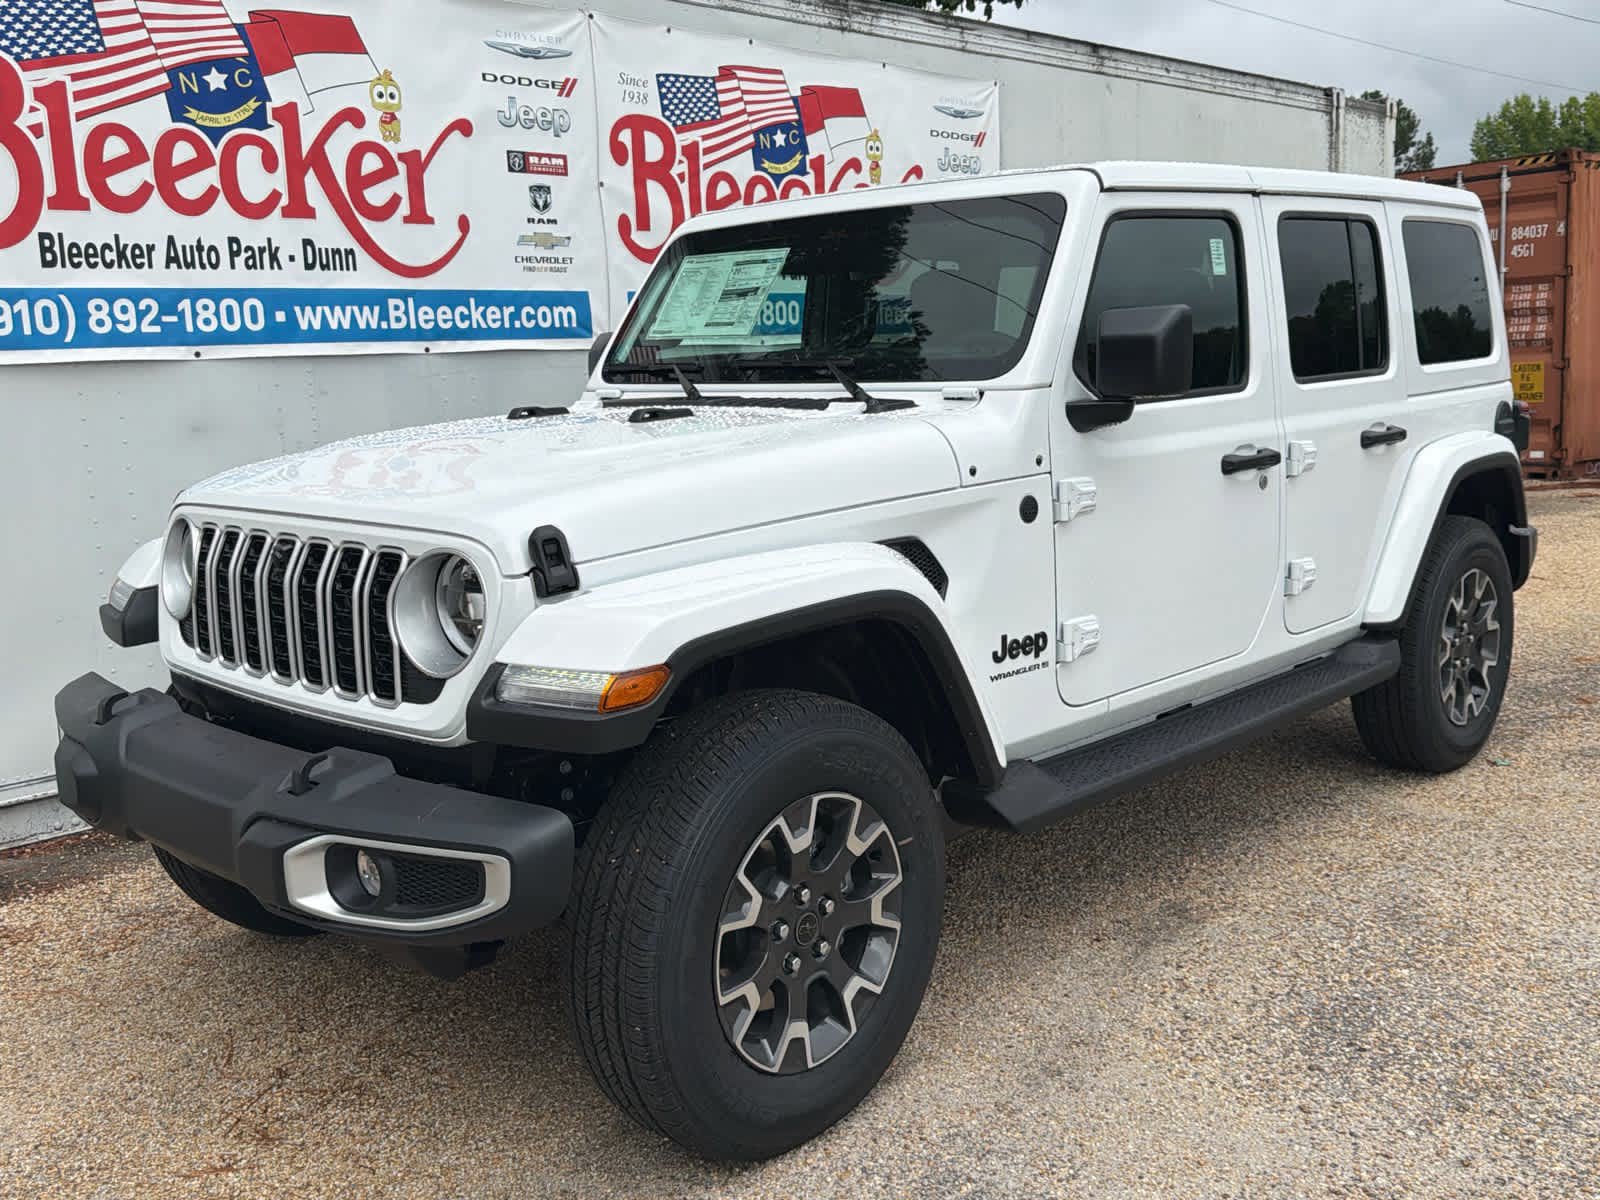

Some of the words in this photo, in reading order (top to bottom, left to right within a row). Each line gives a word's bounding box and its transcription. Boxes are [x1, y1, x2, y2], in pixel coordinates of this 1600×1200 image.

[495, 30, 564, 45] CHRYSLER
[178, 72, 199, 94] N
[234, 68, 253, 88] C
[482, 72, 564, 90] DODGE
[617, 71, 649, 89] Since
[622, 89, 649, 105] 1938
[497, 95, 571, 138] Jeep
[759, 133, 770, 149] N
[930, 129, 979, 142] DODGE
[528, 155, 565, 166] RAM
[937, 146, 982, 175] Jeep
[527, 217, 558, 225] RAM
[1511, 224, 1549, 240] 884037
[38, 232, 156, 270] Bleecker
[165, 234, 221, 271] Auto
[227, 236, 283, 271] Park
[302, 238, 358, 272] Dunn
[514, 255, 575, 265] CHEVROLET
[523, 265, 536, 273] FIND
[87, 297, 265, 334] 892-1800
[294, 297, 577, 329] www.Bleecker.com
[992, 631, 1048, 664] Jeep
[989, 664, 1040, 682] WRANGLER
